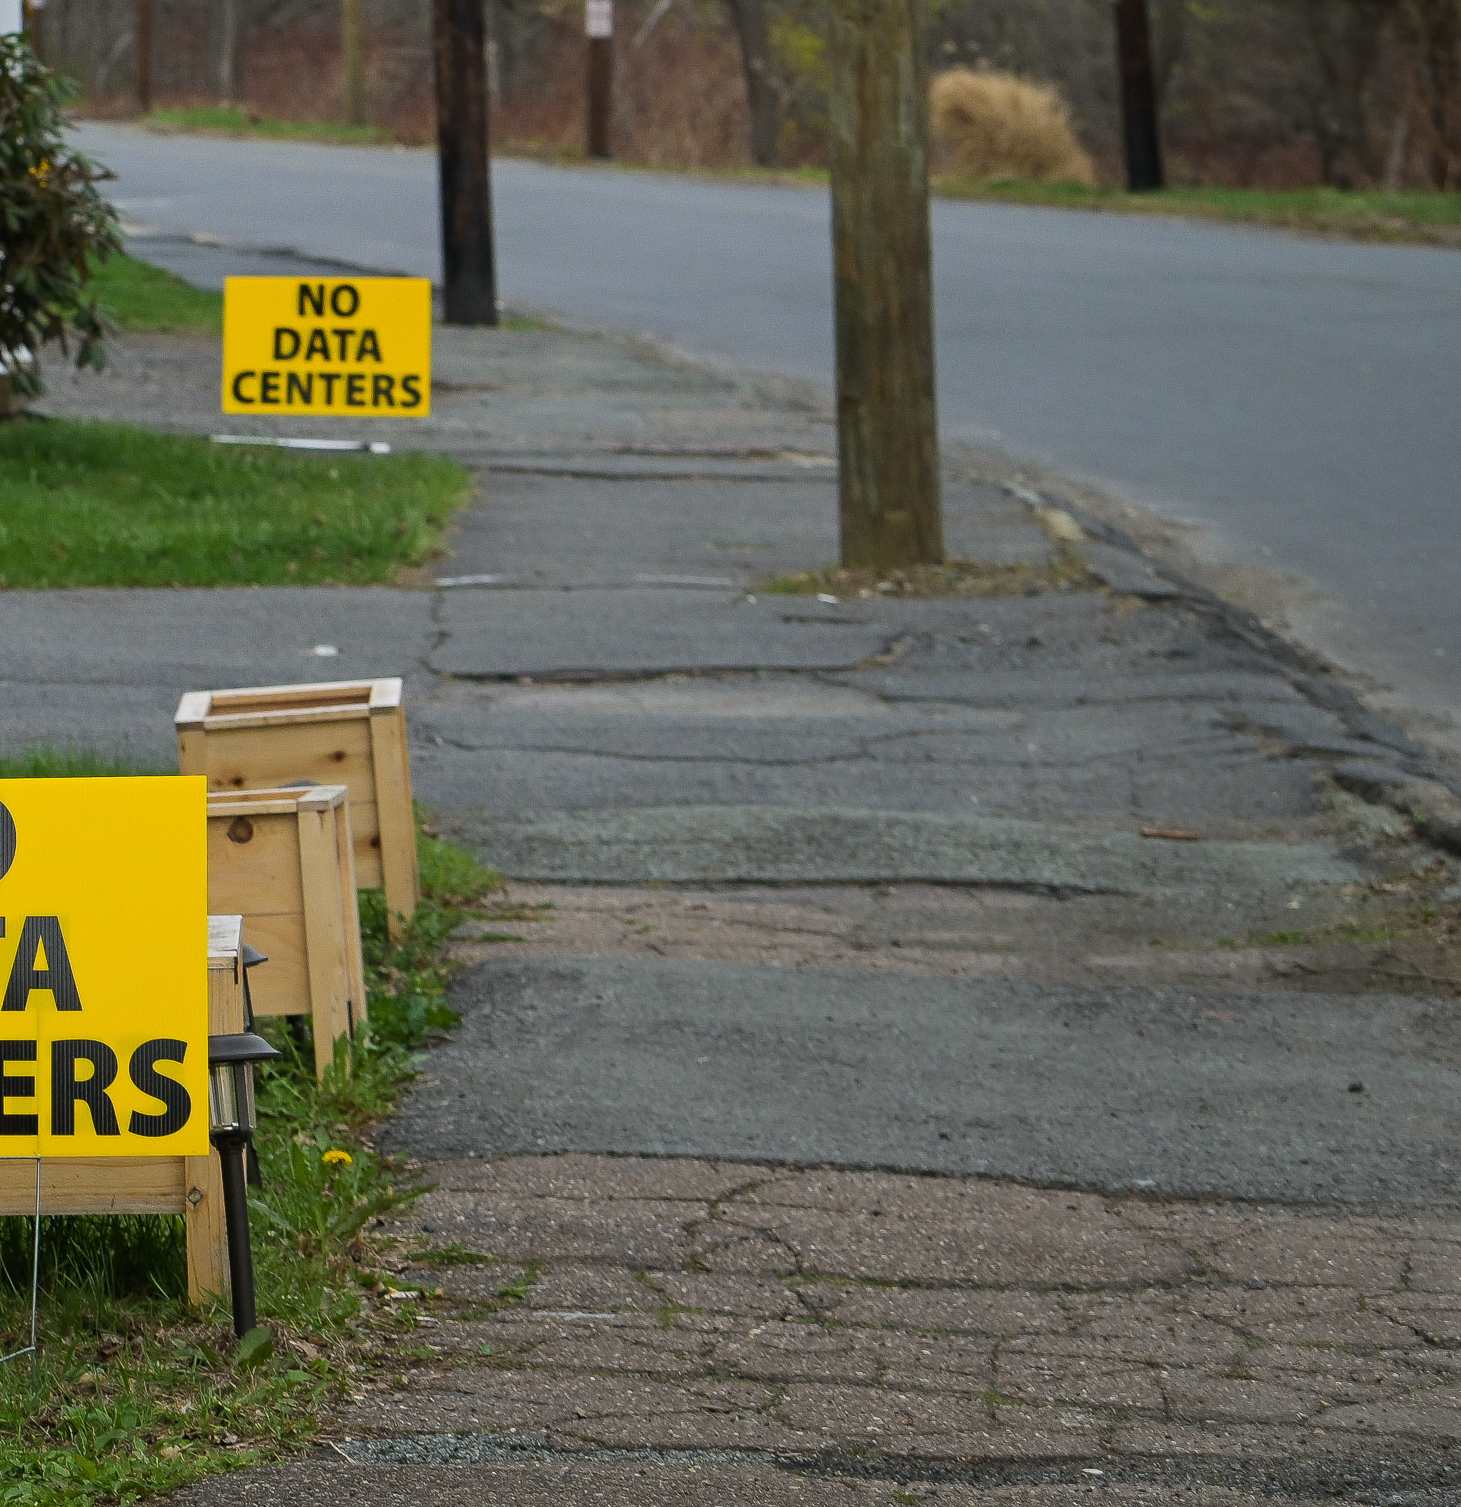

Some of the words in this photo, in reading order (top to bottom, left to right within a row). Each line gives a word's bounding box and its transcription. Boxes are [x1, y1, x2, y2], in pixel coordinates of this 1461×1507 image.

[297, 283, 360, 318] NO
[273, 327, 383, 363] DATA
[231, 370, 423, 409] CENTERS
